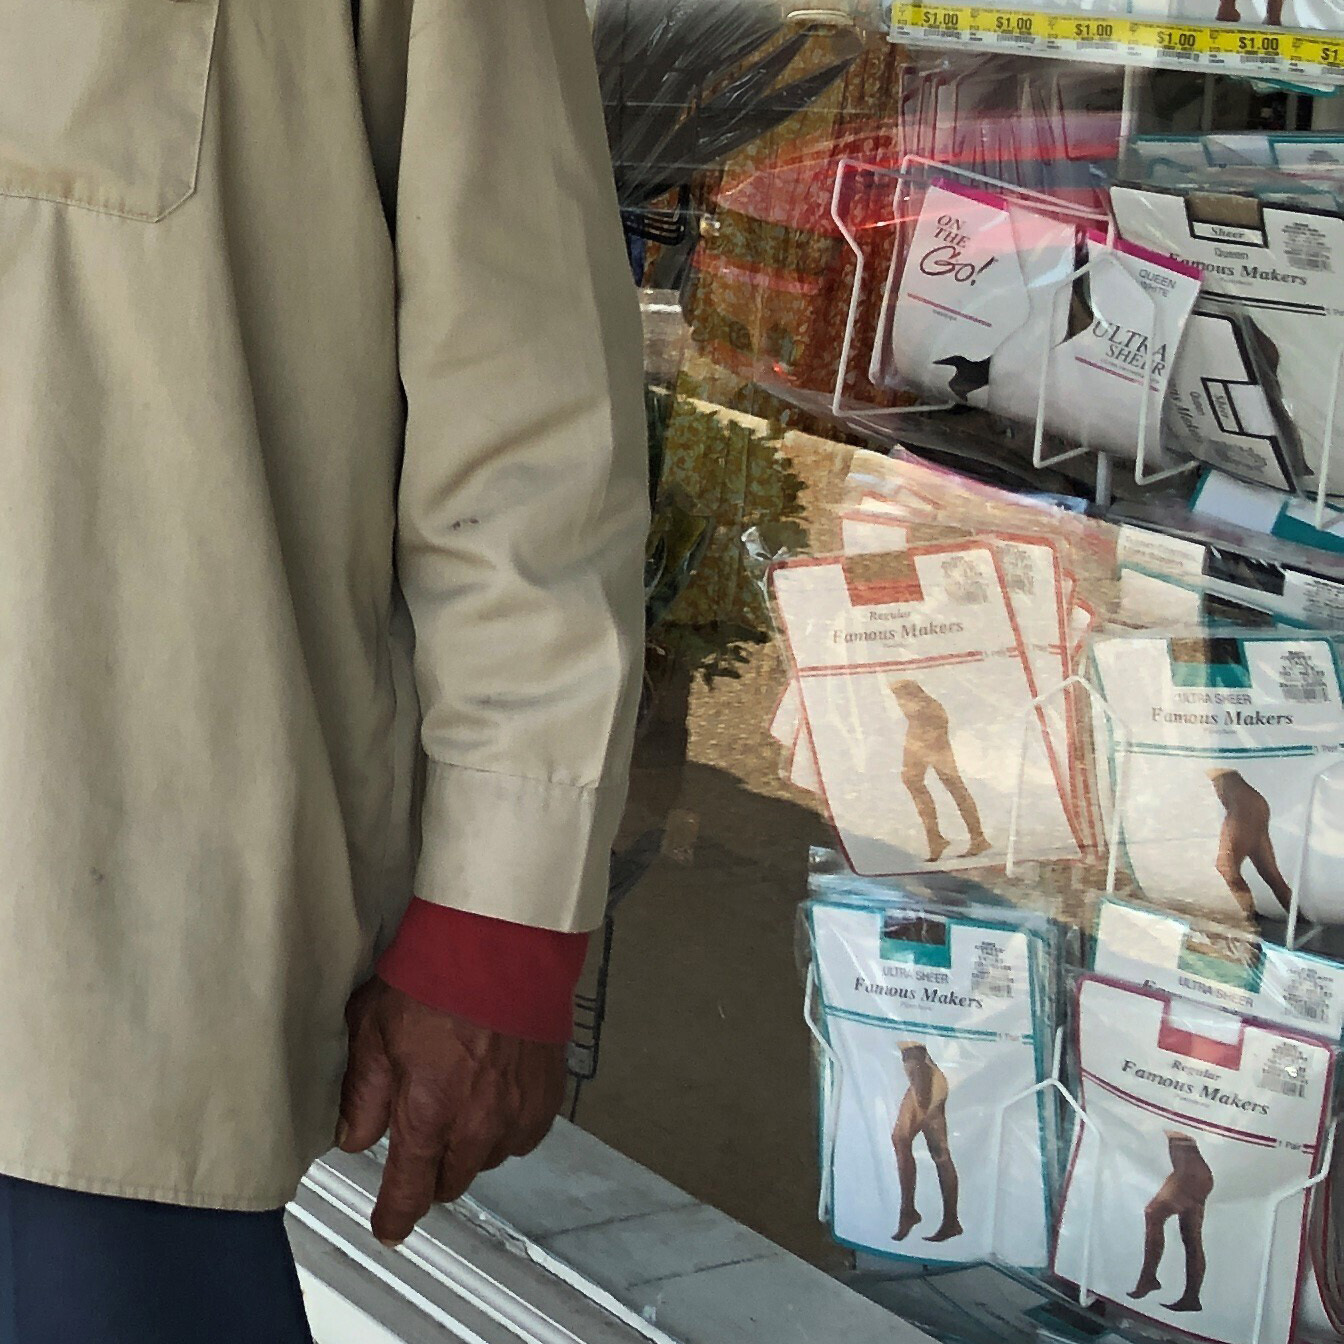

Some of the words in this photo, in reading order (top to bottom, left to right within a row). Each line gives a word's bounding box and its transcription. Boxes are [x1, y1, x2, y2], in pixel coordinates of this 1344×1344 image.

[923, 11, 959, 26] $1.00
[995, 16, 1033, 31] $1.00
[1074, 22, 1113, 37] $1.00
[1156, 30, 1196, 47] $1.00
[1238, 36, 1279, 51] $1.00
[937, 214, 967, 231] ON
[934, 227, 971, 248] THE
[1211, 226, 1245, 239] Sheer
[920, 245, 999, 286] Go!
[1139, 269, 1177, 289] QUEEN
[1240, 265, 1307, 286] Makers
[833, 628, 896, 644] Famous
[901, 621, 964, 639] Makers
[1152, 707, 1219, 726] Famous
[1224, 710, 1294, 726] Makers
[915, 971, 950, 984] SHEER
[854, 977, 916, 1000] Famous
[922, 987, 984, 1009] Makers
[1171, 1059, 1222, 1082] Regular
[1121, 1059, 1194, 1095] Famous
[1200, 1084, 1271, 1116] Makers
